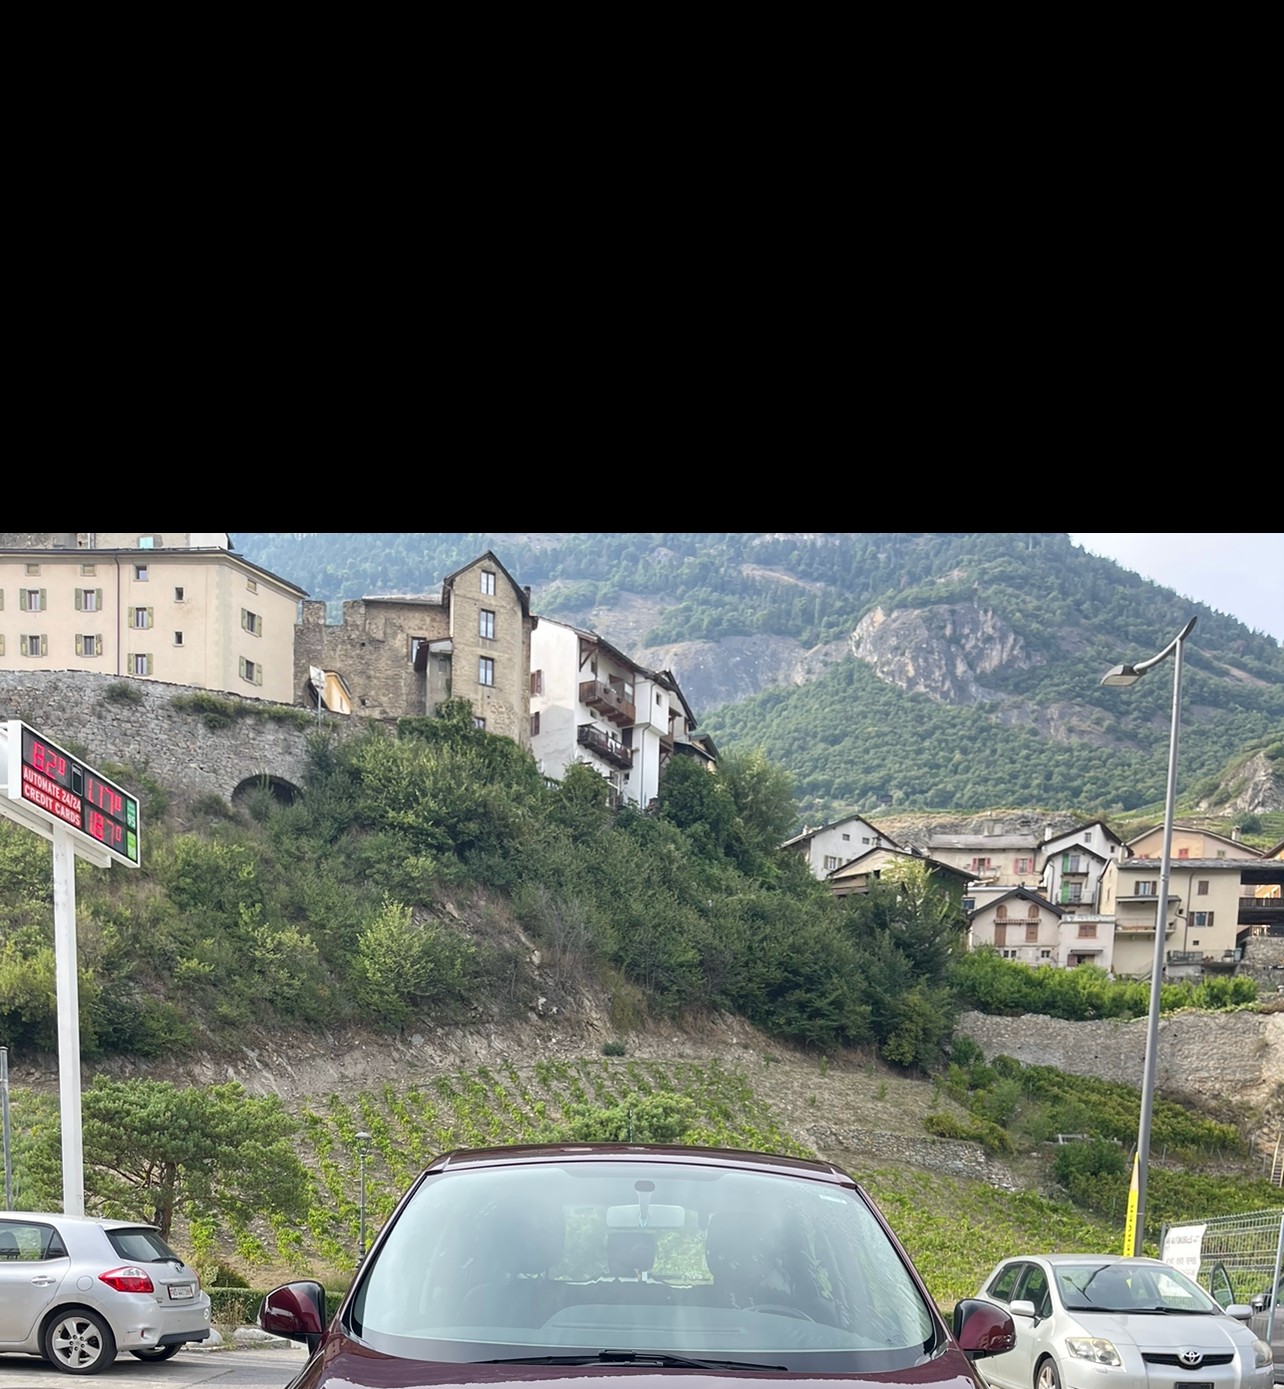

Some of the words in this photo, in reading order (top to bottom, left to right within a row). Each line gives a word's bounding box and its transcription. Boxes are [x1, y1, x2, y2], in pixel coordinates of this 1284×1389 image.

[23, 767, 60, 799] AUTOMATE
[61, 789, 82, 812] 24/24
[24, 784, 53, 812] CREDIT
[54, 801, 81, 826] CARDS
